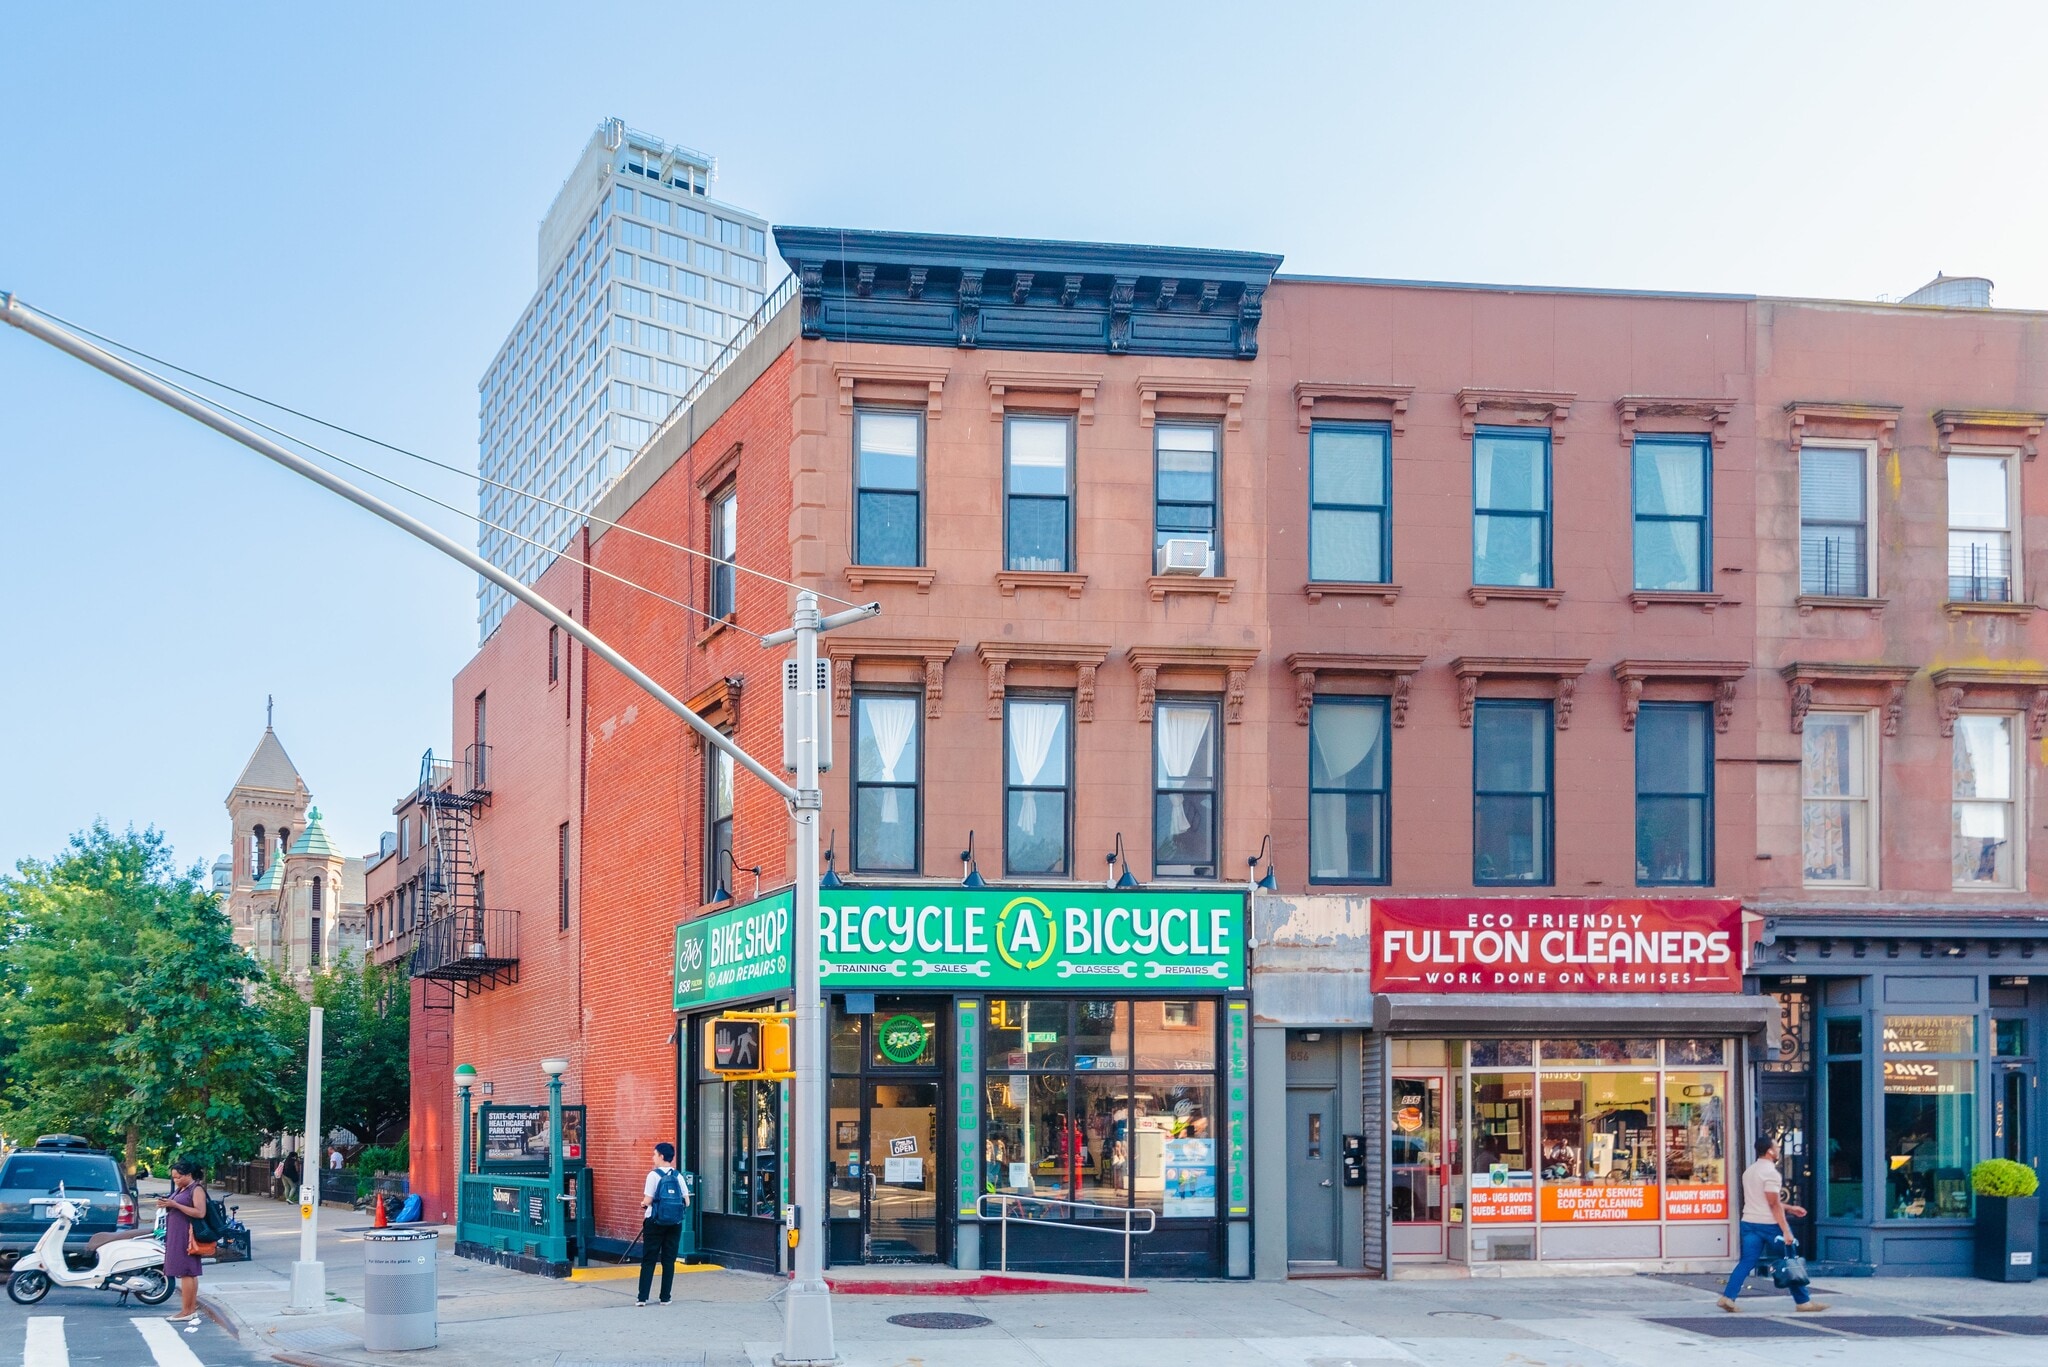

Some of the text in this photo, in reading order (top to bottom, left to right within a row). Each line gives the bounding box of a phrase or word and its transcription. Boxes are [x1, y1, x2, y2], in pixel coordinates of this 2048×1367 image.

[1468, 914, 1643, 929] ECO FRIENDLY
[819, 905, 1231, 955] RECYCLE A BICYCLE
[711, 908, 787, 968] BIKE SHOP
[1383, 930, 1731, 964] FULTON CLEANERS
[716, 959, 777, 986] AND REPAIRS
[836, 964, 1209, 974] TRAINING SALES CLASSES REPAIRS
[1425, 972, 1692, 984] WORK DONE ON PREMISES
[678, 980, 691, 994] 858
[887, 1031, 919, 1046] 858
[960, 1013, 974, 1073] BIKE
[488, 1112, 540, 1120] STATE-OF-THE-ART
[894, 1144, 914, 1154] OPEN
[961, 1142, 974, 1204] YORK
[1472, 1193, 1488, 1203] RUG
[1492, 1193, 1508, 1202] UGG
[1509, 1192, 1533, 1202] BOOTS
[1557, 1187, 1644, 1198] SAME-DAY SERVICE
[1665, 1190, 1726, 1201] LAUNDRY SHIRTS
[1557, 1198, 1644, 1209] ECO DRY CLEANING
[1669, 1204, 1722, 1214] WASH & FOLD
[1472, 1206, 1496, 1216] SUEDE
[1501, 1205, 1533, 1215] LEATHER
[1572, 1209, 1628, 1219] ALTERATION
